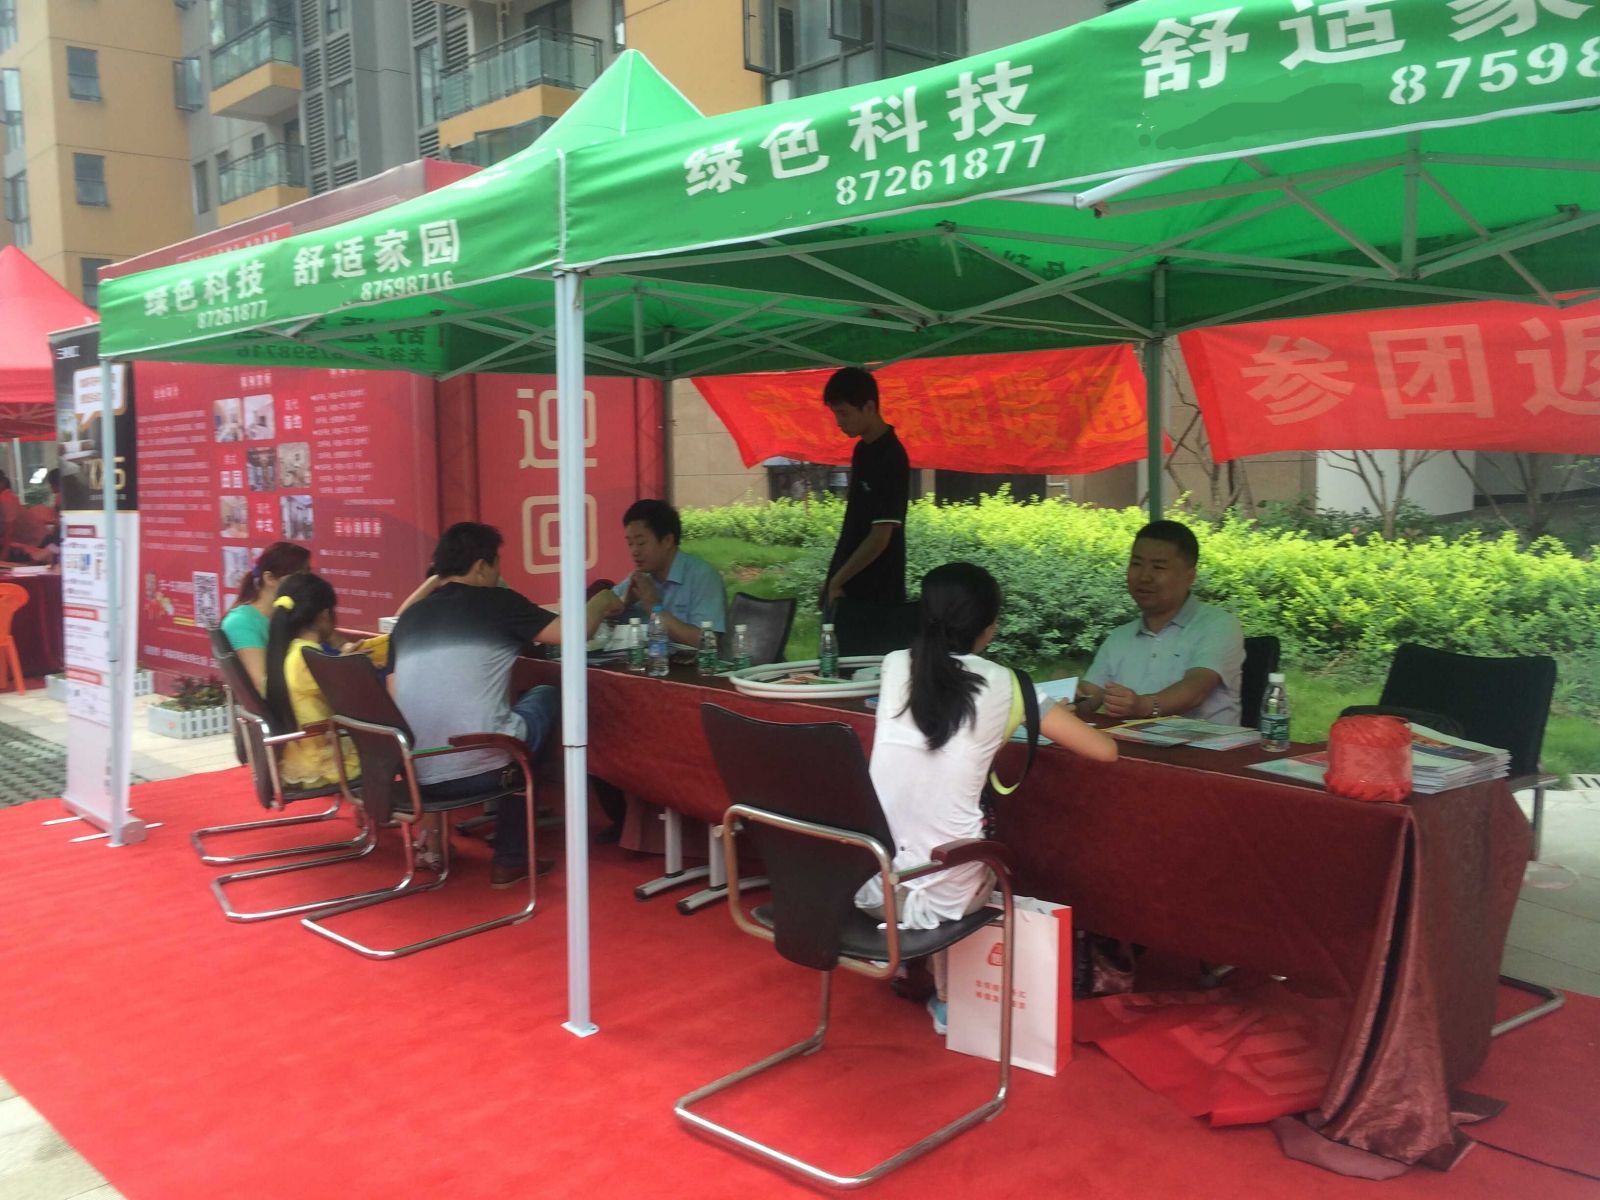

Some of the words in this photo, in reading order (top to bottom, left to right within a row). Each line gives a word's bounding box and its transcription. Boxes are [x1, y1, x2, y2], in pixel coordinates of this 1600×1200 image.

[684, 60, 1038, 197] 绿色科技
[834, 133, 1048, 206] 87261877
[1388, 37, 1600, 105] 87598
[143, 259, 265, 316] 绿色科技
[293, 219, 461, 287] 舒适家园
[197, 300, 268, 330] 87261877
[360, 270, 454, 301] 87598716
[746, 364, 1148, 452] 武绿园暖通
[1241, 315, 1600, 426] 参团返
